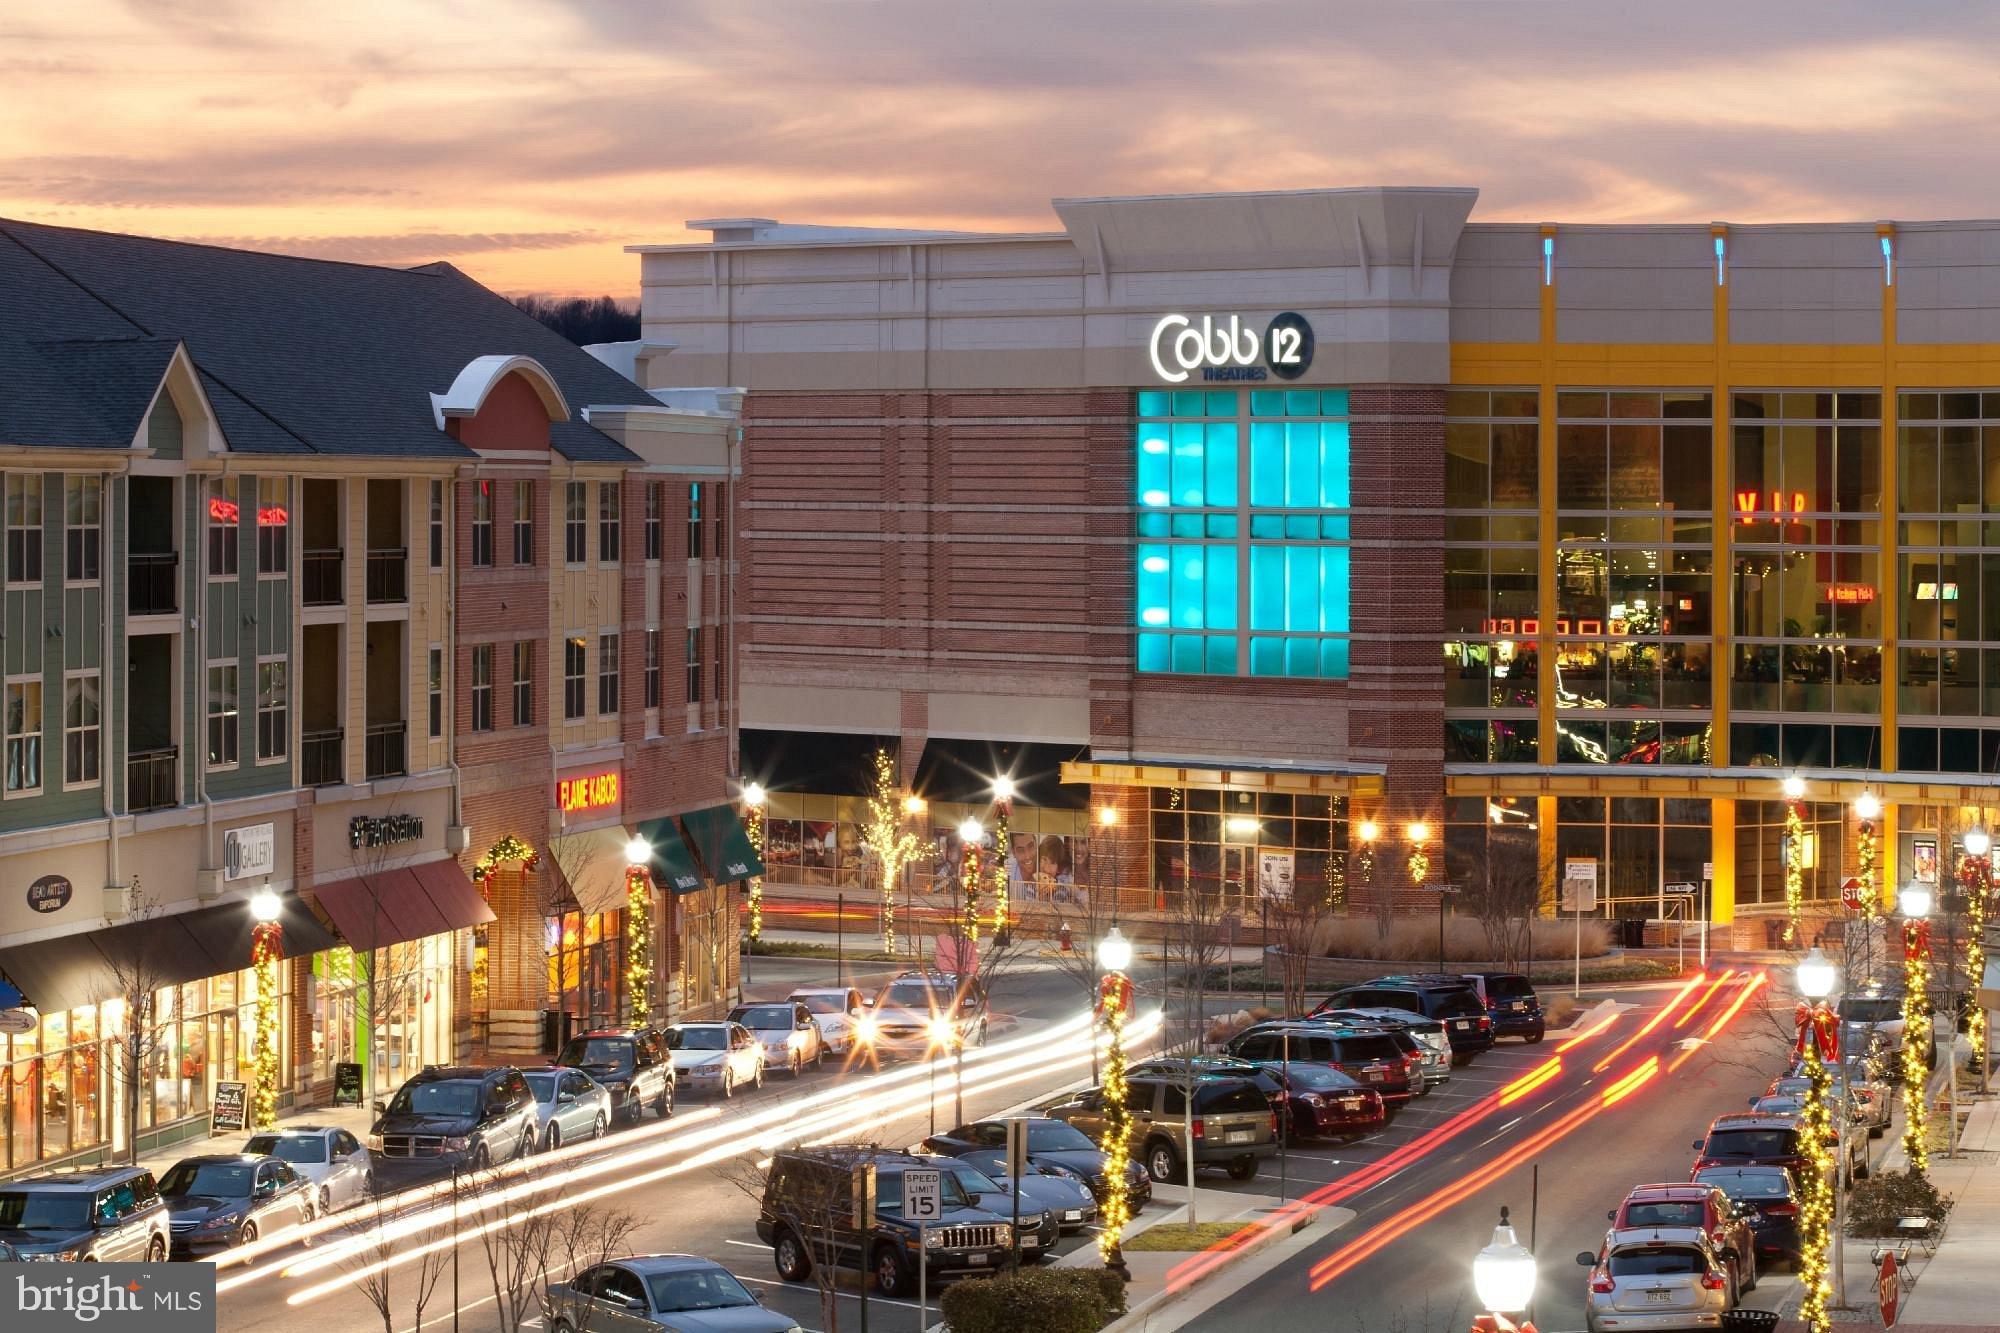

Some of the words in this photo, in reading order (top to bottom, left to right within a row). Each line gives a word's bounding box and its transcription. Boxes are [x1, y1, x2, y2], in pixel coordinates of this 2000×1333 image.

[1150, 314, 1259, 383] Cobb
[1272, 327, 1301, 363] 12
[1201, 366, 1268, 382] THEATRES
[1737, 492, 1805, 524] VIP
[1828, 588, 1857, 600] Ktchen
[561, 778, 588, 811] FLAME
[589, 773, 617, 807] KABOB
[373, 819, 389, 848] Art
[391, 815, 424, 843] Station
[242, 839, 271, 869] GALLERY
[1844, 887, 1865, 901] STO
[906, 1174, 938, 1183] SPEED
[910, 1185, 935, 1194] LIMIT
[910, 1196, 934, 1215] 15
[1880, 1273, 1897, 1307] STOP
